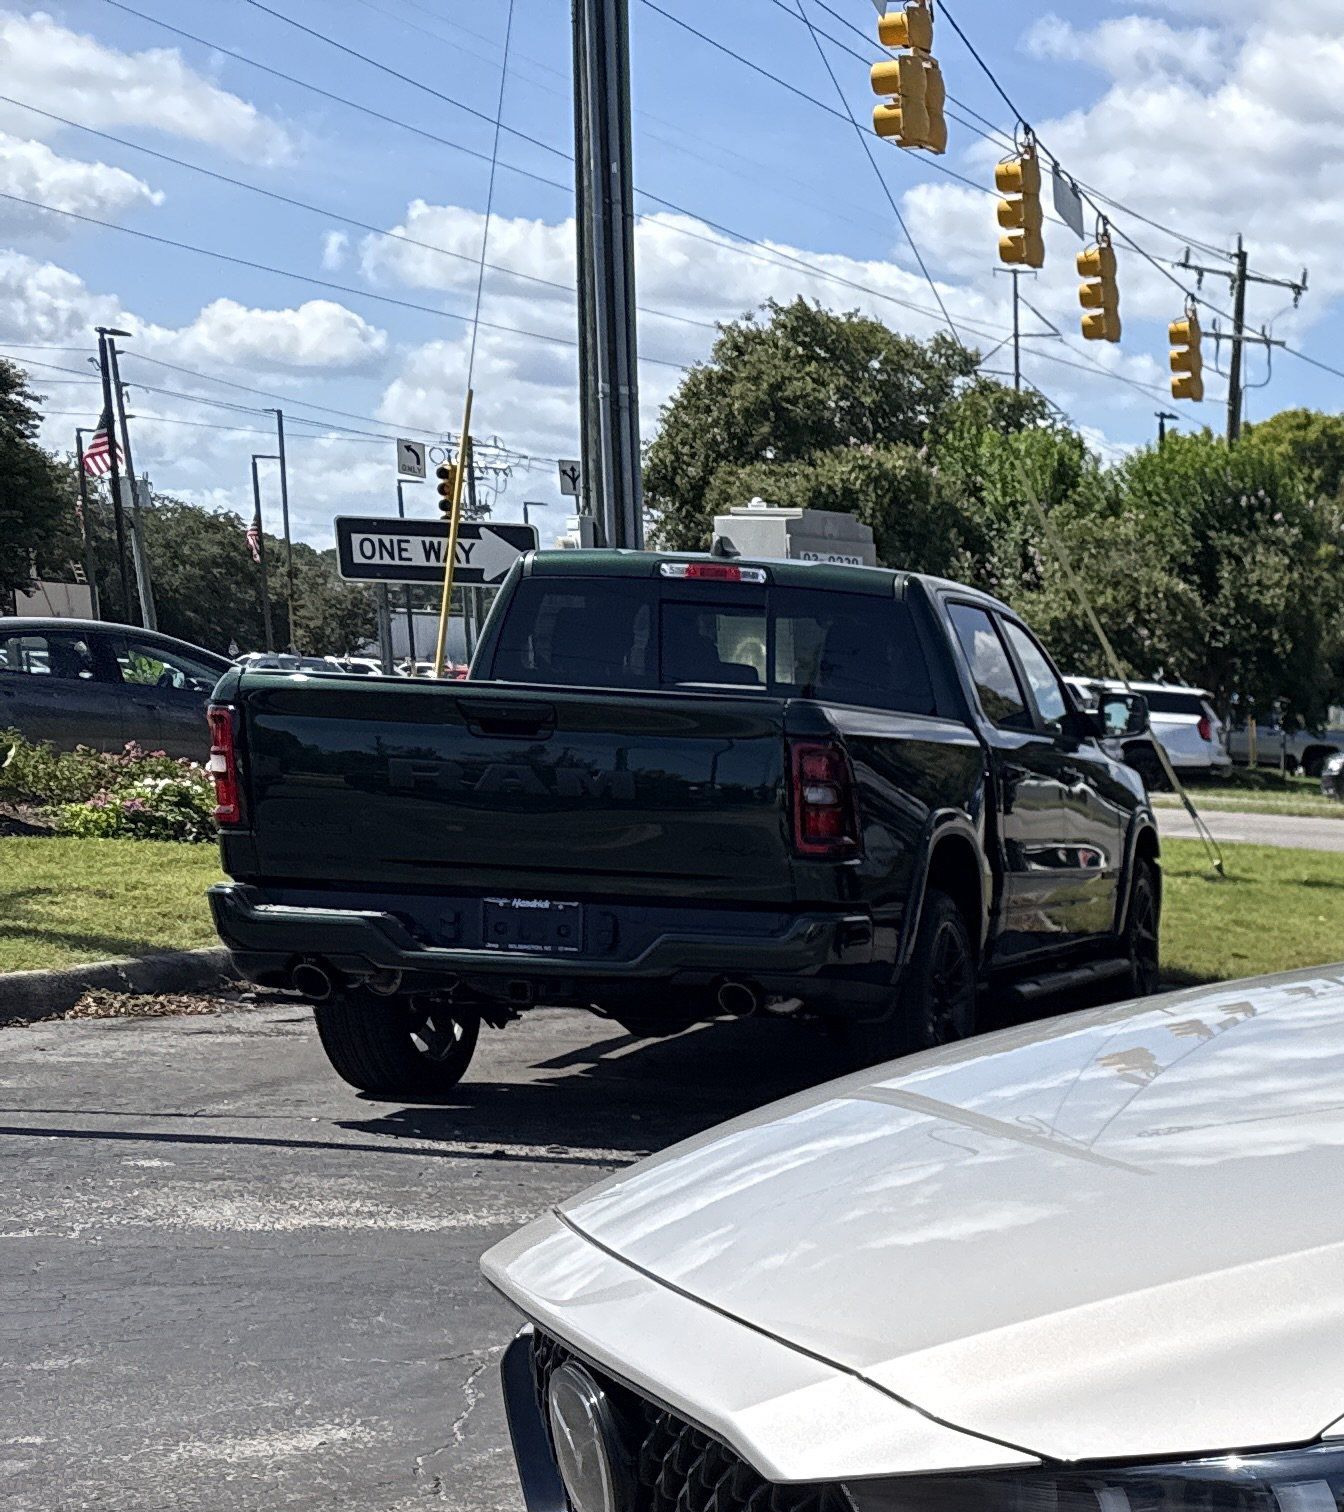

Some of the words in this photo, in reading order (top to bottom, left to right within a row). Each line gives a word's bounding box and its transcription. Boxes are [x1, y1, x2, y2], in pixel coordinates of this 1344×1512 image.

[401, 464, 422, 474] ONLY
[359, 537, 411, 562] ONE
[388, 758, 637, 800] RAM
